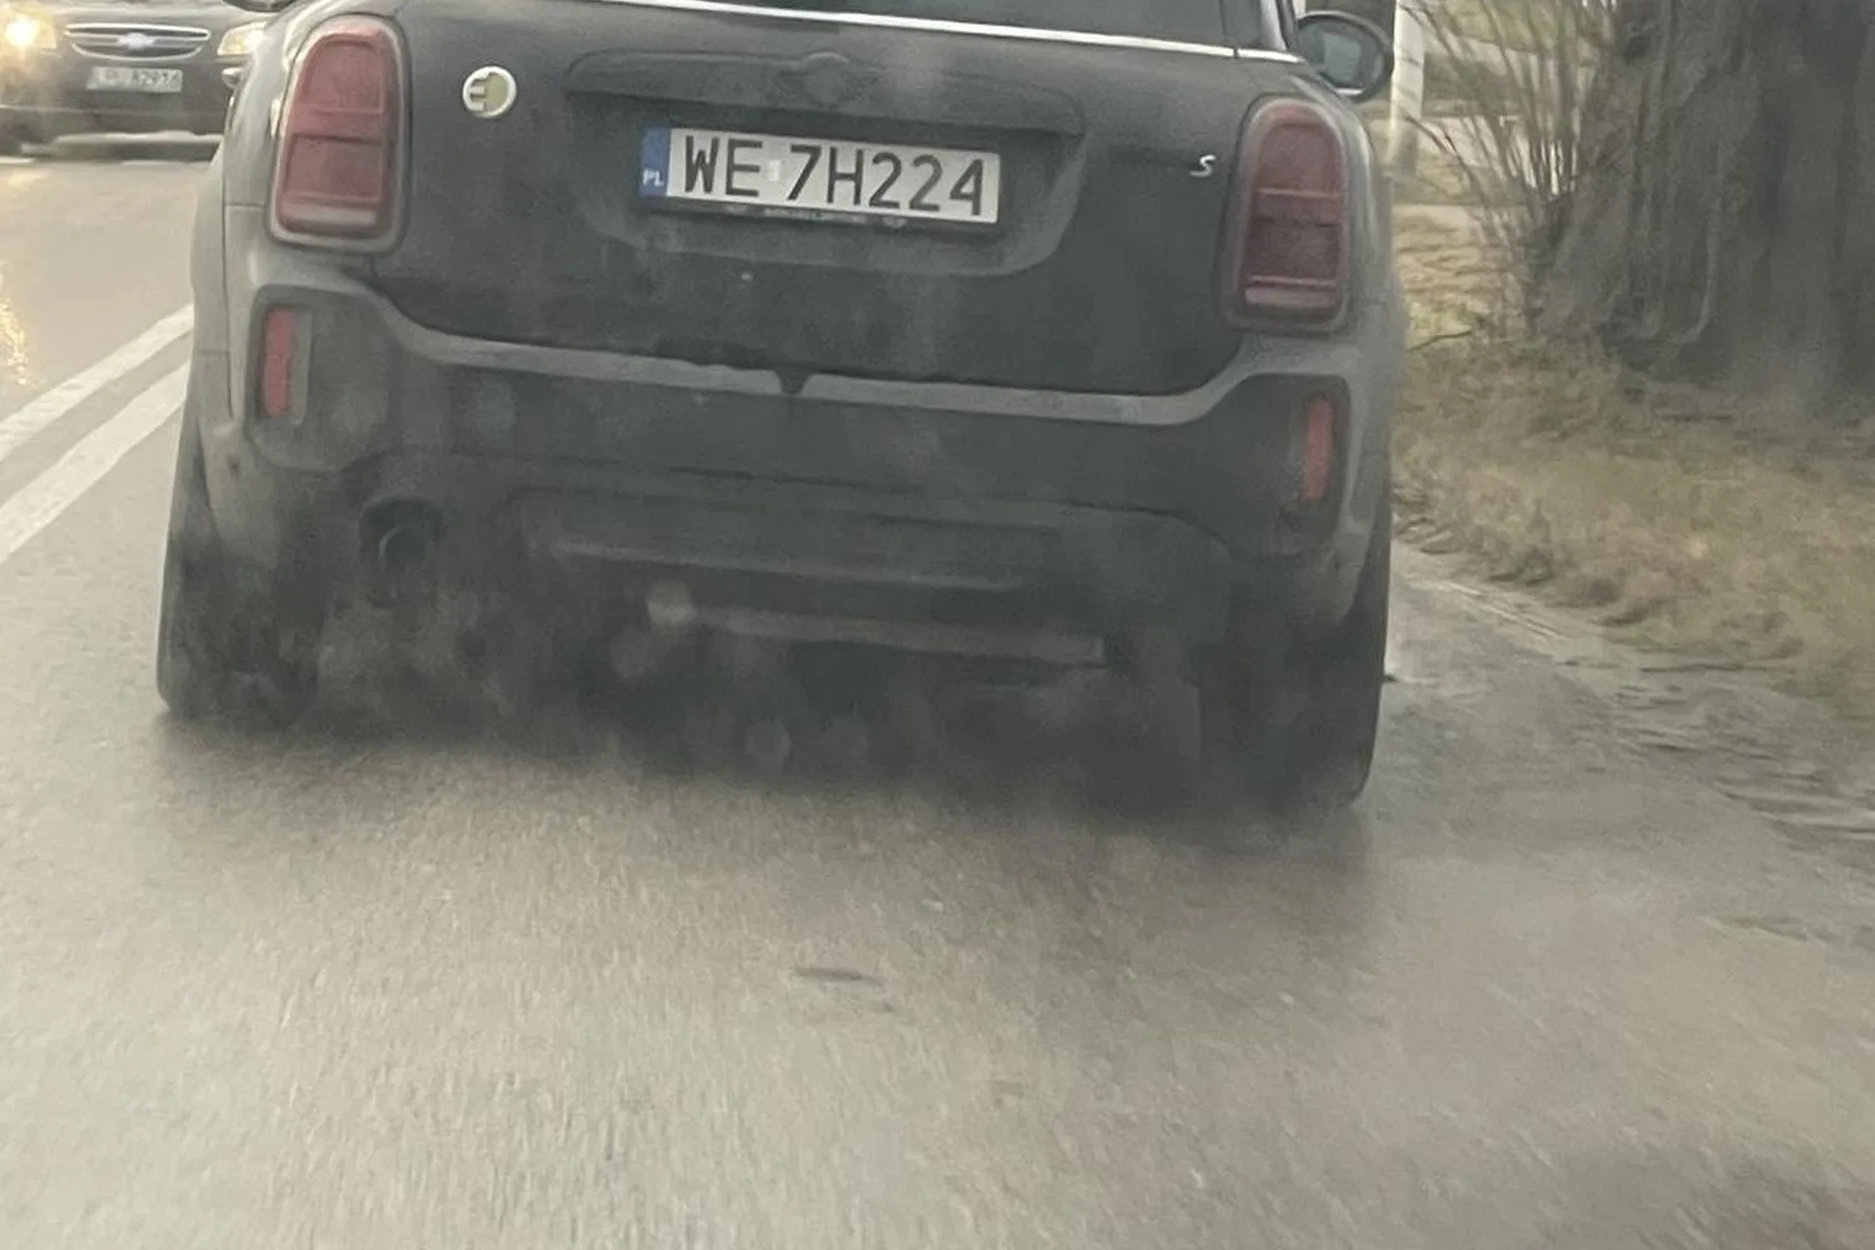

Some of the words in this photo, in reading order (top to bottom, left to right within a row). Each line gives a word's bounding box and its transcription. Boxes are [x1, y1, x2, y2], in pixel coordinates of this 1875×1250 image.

[684, 135, 763, 197] WE
[785, 144, 985, 217] 7H224
[1190, 154, 1216, 178] S
[643, 169, 665, 188] PL
